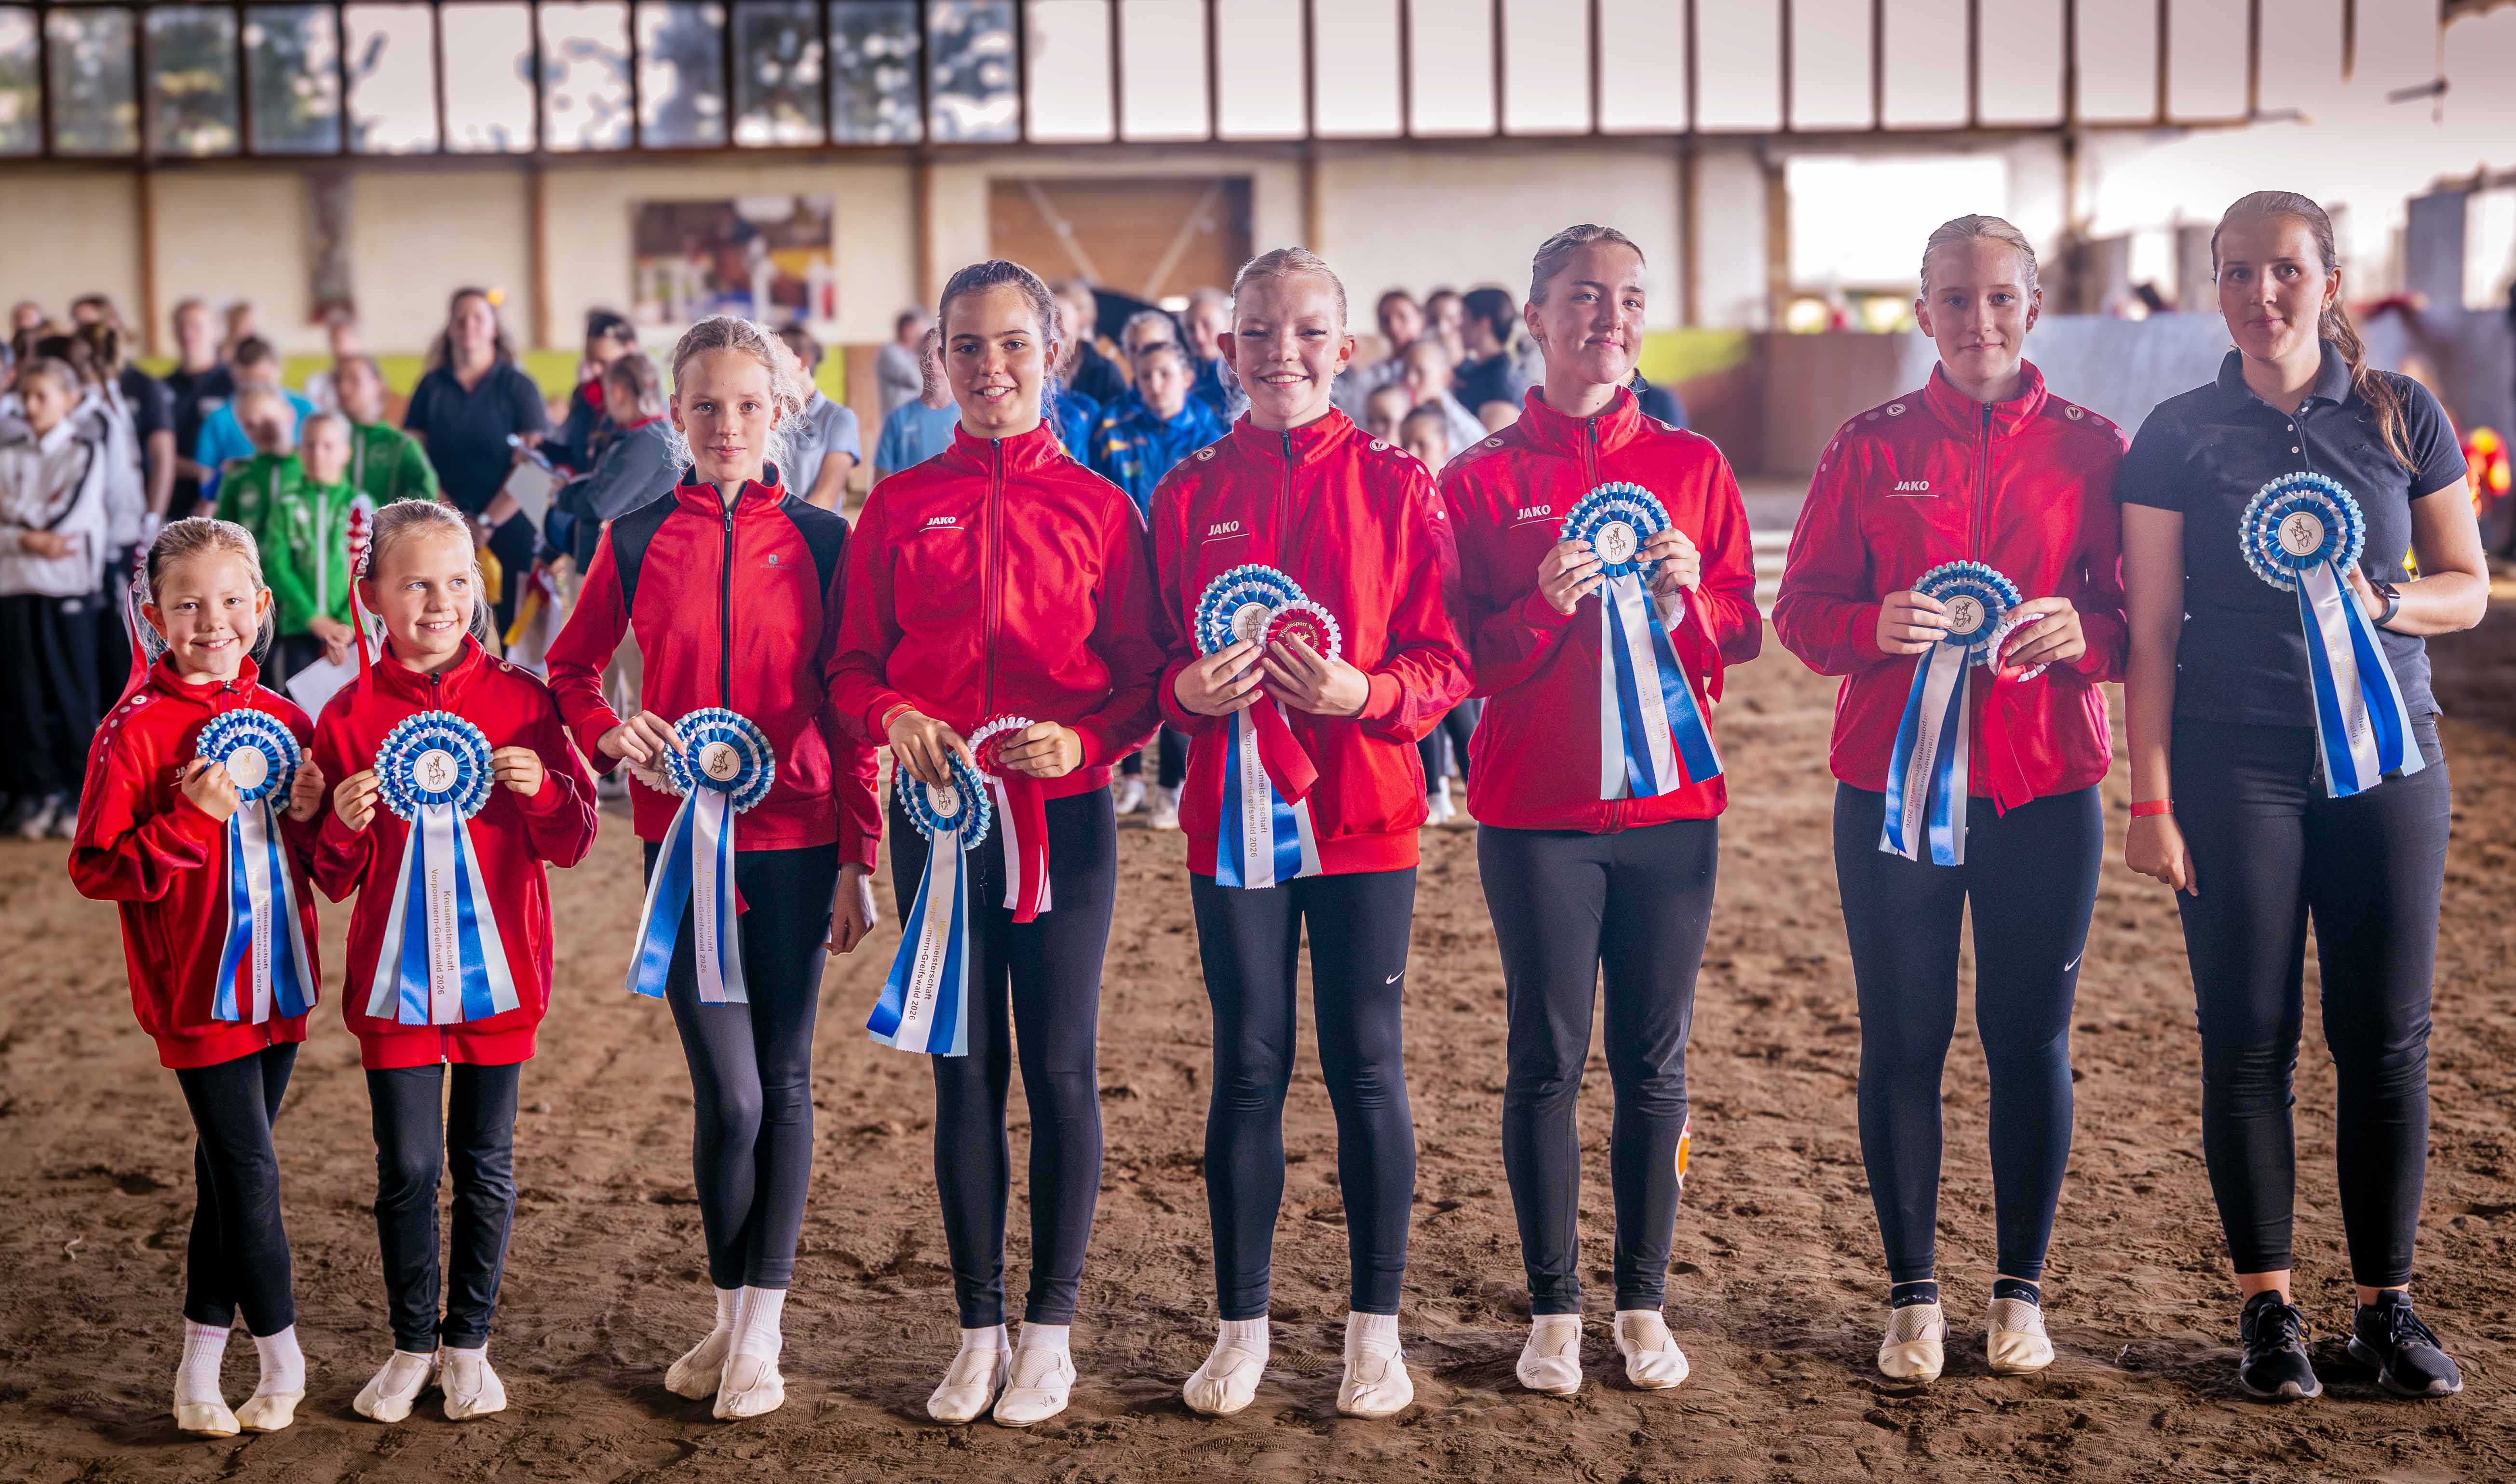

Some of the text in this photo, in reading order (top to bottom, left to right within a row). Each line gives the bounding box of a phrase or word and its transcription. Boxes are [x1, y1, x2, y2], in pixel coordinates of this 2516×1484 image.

[1893, 481, 1929, 490] JAKO
[927, 516, 956, 525] JAKO
[1517, 505, 1551, 520] JAKO
[1208, 521, 1239, 536] JAKO
[1279, 621, 1319, 650] Pferdesport Wusterhu
[176, 767, 186, 778] JA
[1257, 755, 1268, 834] eismeisterschaft
[1249, 837, 1258, 858] 2026
[431, 869, 445, 995] Vorpommern-Greifswald 2026
[444, 890, 455, 971] Kreismeisterschaft
[908, 1000, 919, 1021] 2026
